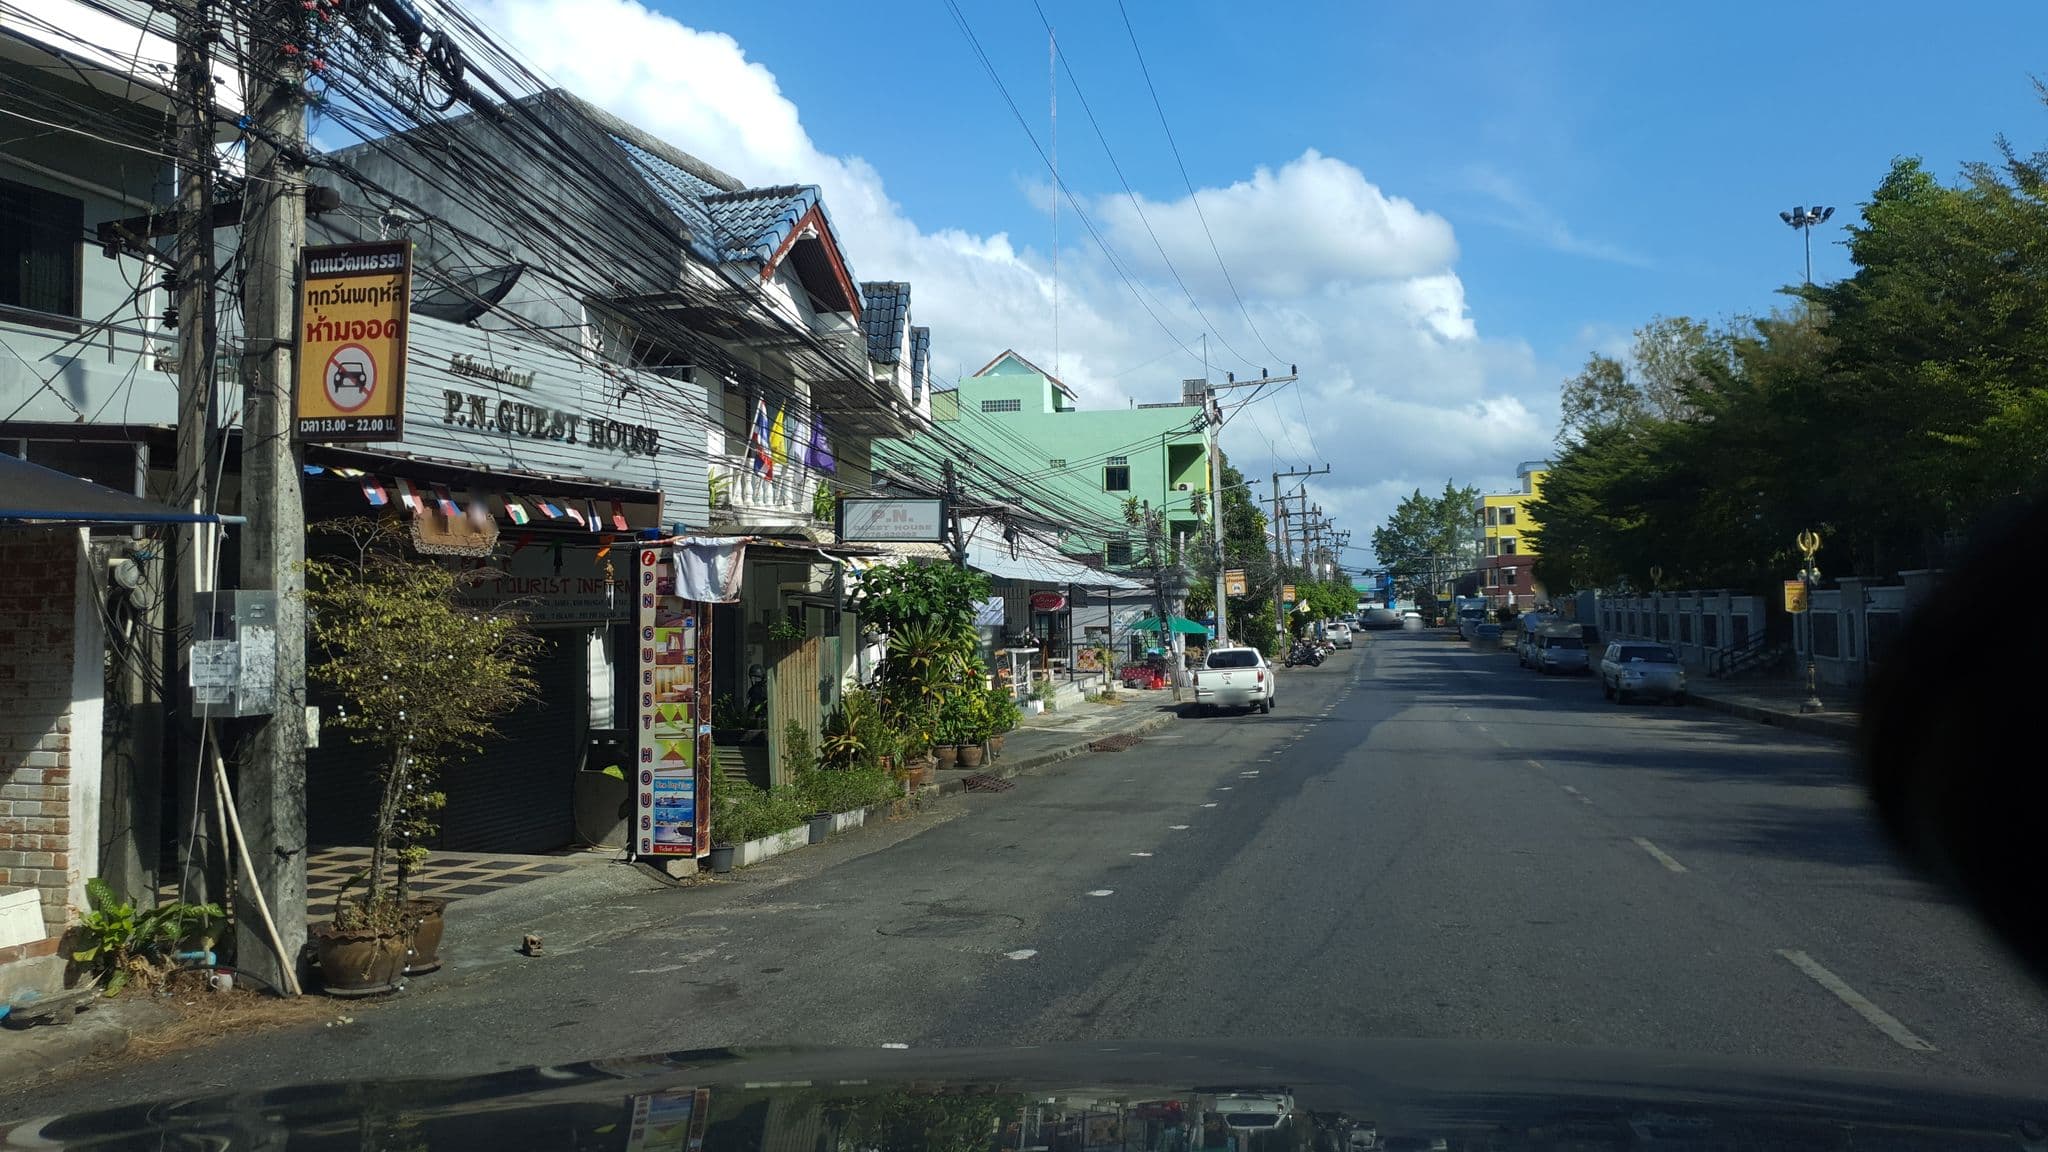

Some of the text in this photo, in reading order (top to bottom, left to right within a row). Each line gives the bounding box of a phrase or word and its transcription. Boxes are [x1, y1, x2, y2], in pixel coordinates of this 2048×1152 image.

[307, 276, 402, 313] ทุกวันพฤหัส
[306, 315, 400, 342] ห้ามจอด
[321, 419, 347, 432] 13.00
[356, 419, 384, 431] 22.00
[586, 417, 660, 457] HOUSE
[641, 626, 654, 730] GUEST
[640, 748, 653, 853] HOUSE
